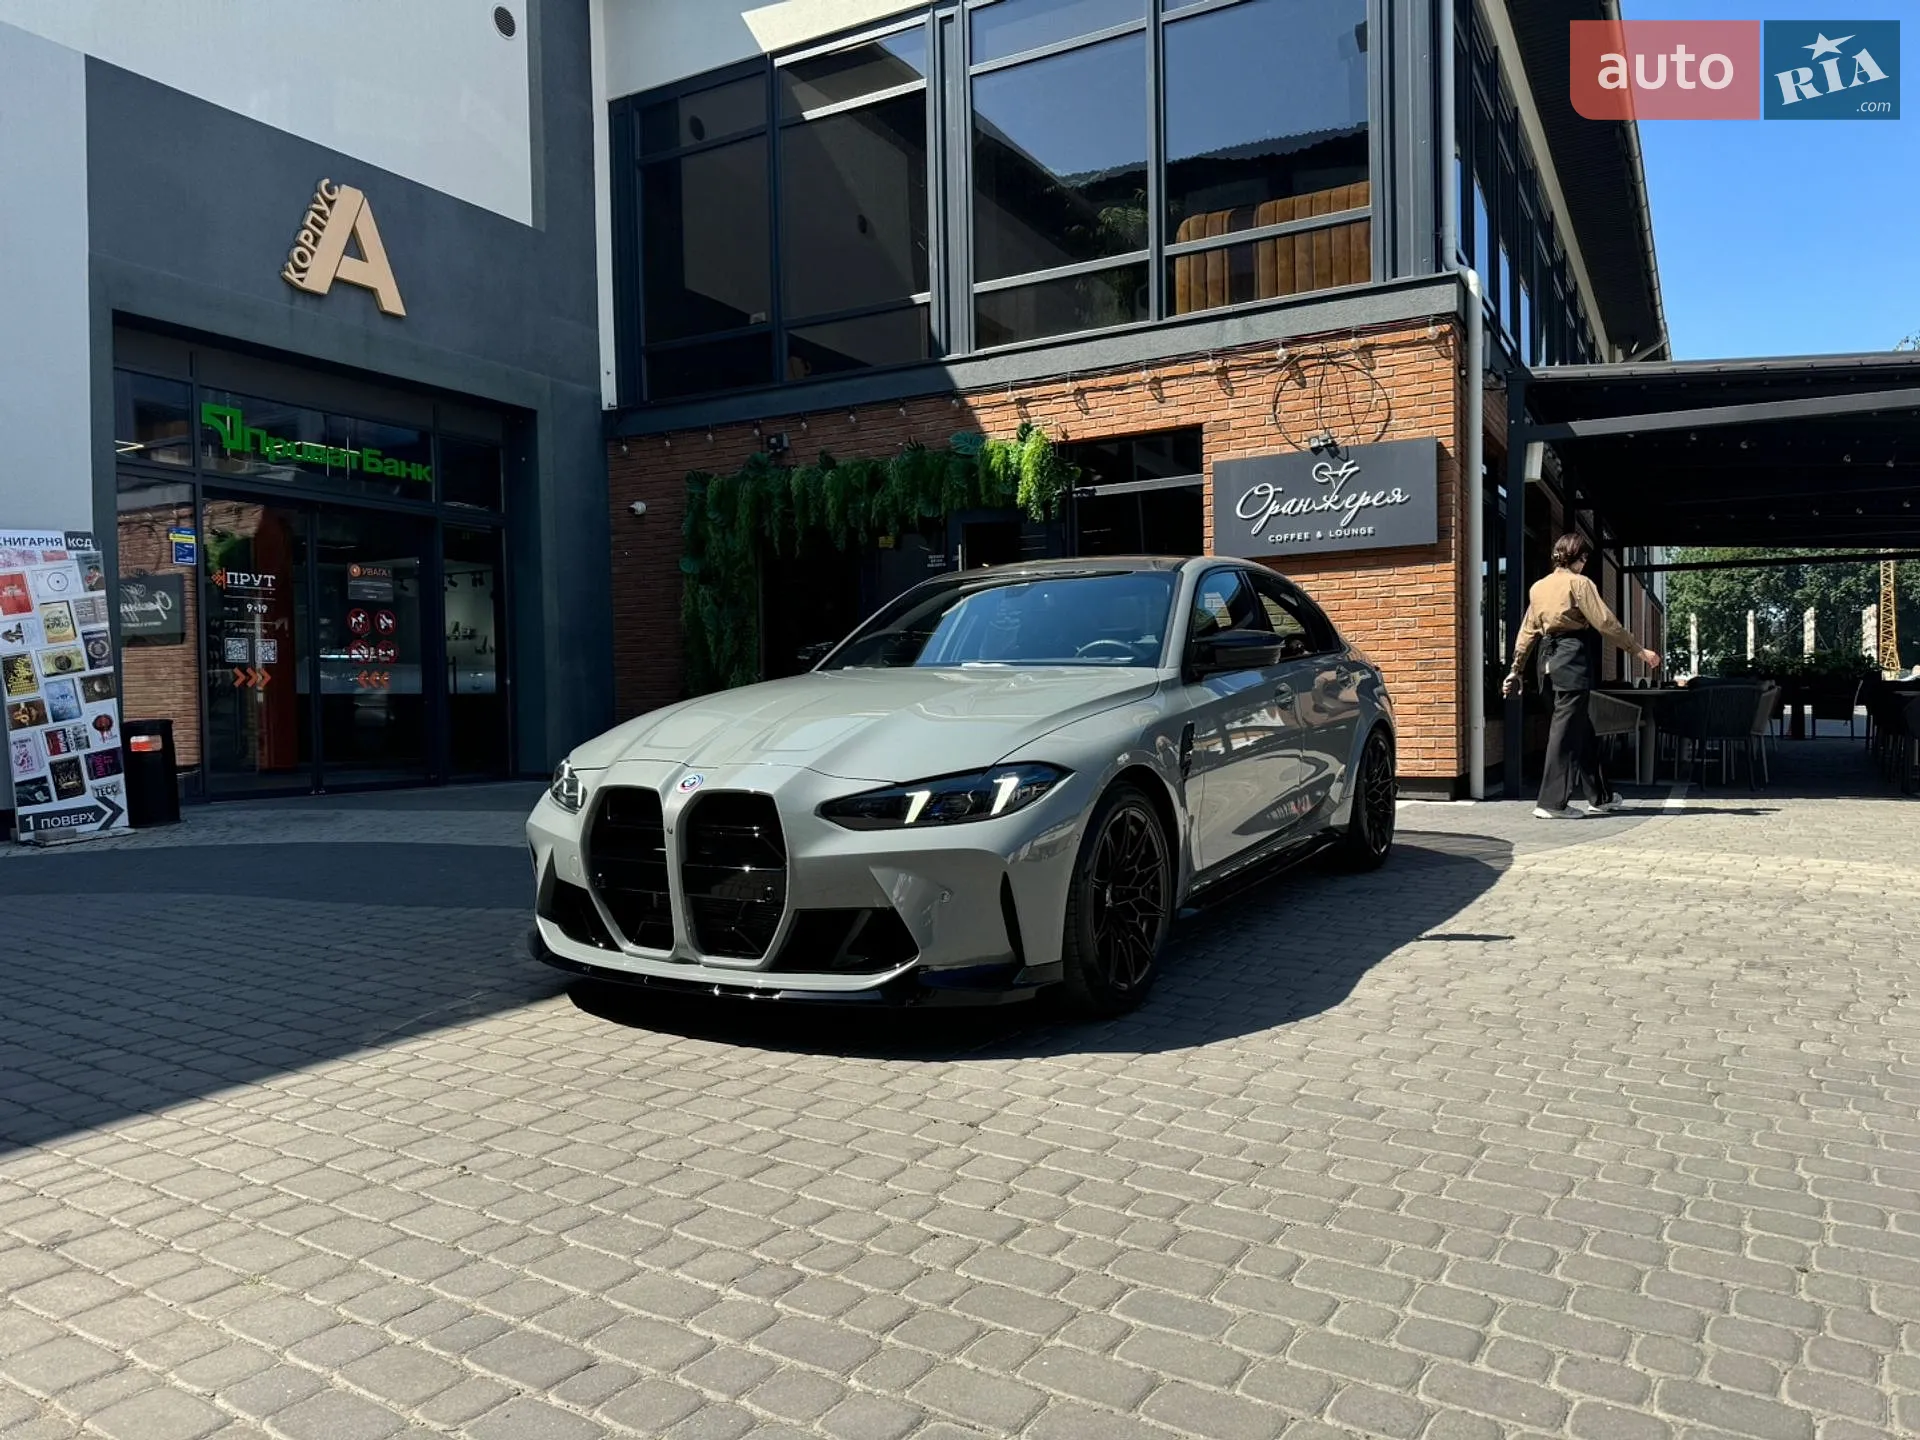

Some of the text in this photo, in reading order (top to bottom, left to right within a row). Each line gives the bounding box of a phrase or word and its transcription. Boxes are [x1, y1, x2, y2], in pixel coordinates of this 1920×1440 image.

[279, 177, 341, 288] КОРПУС
[1235, 470, 1411, 535] Оранжерея
[1267, 526, 1375, 544] COFFEE & LOUNGE
[226, 571, 276, 588] ПРУТ
[25, 811, 96, 831] 1 ПОВЕРХ
